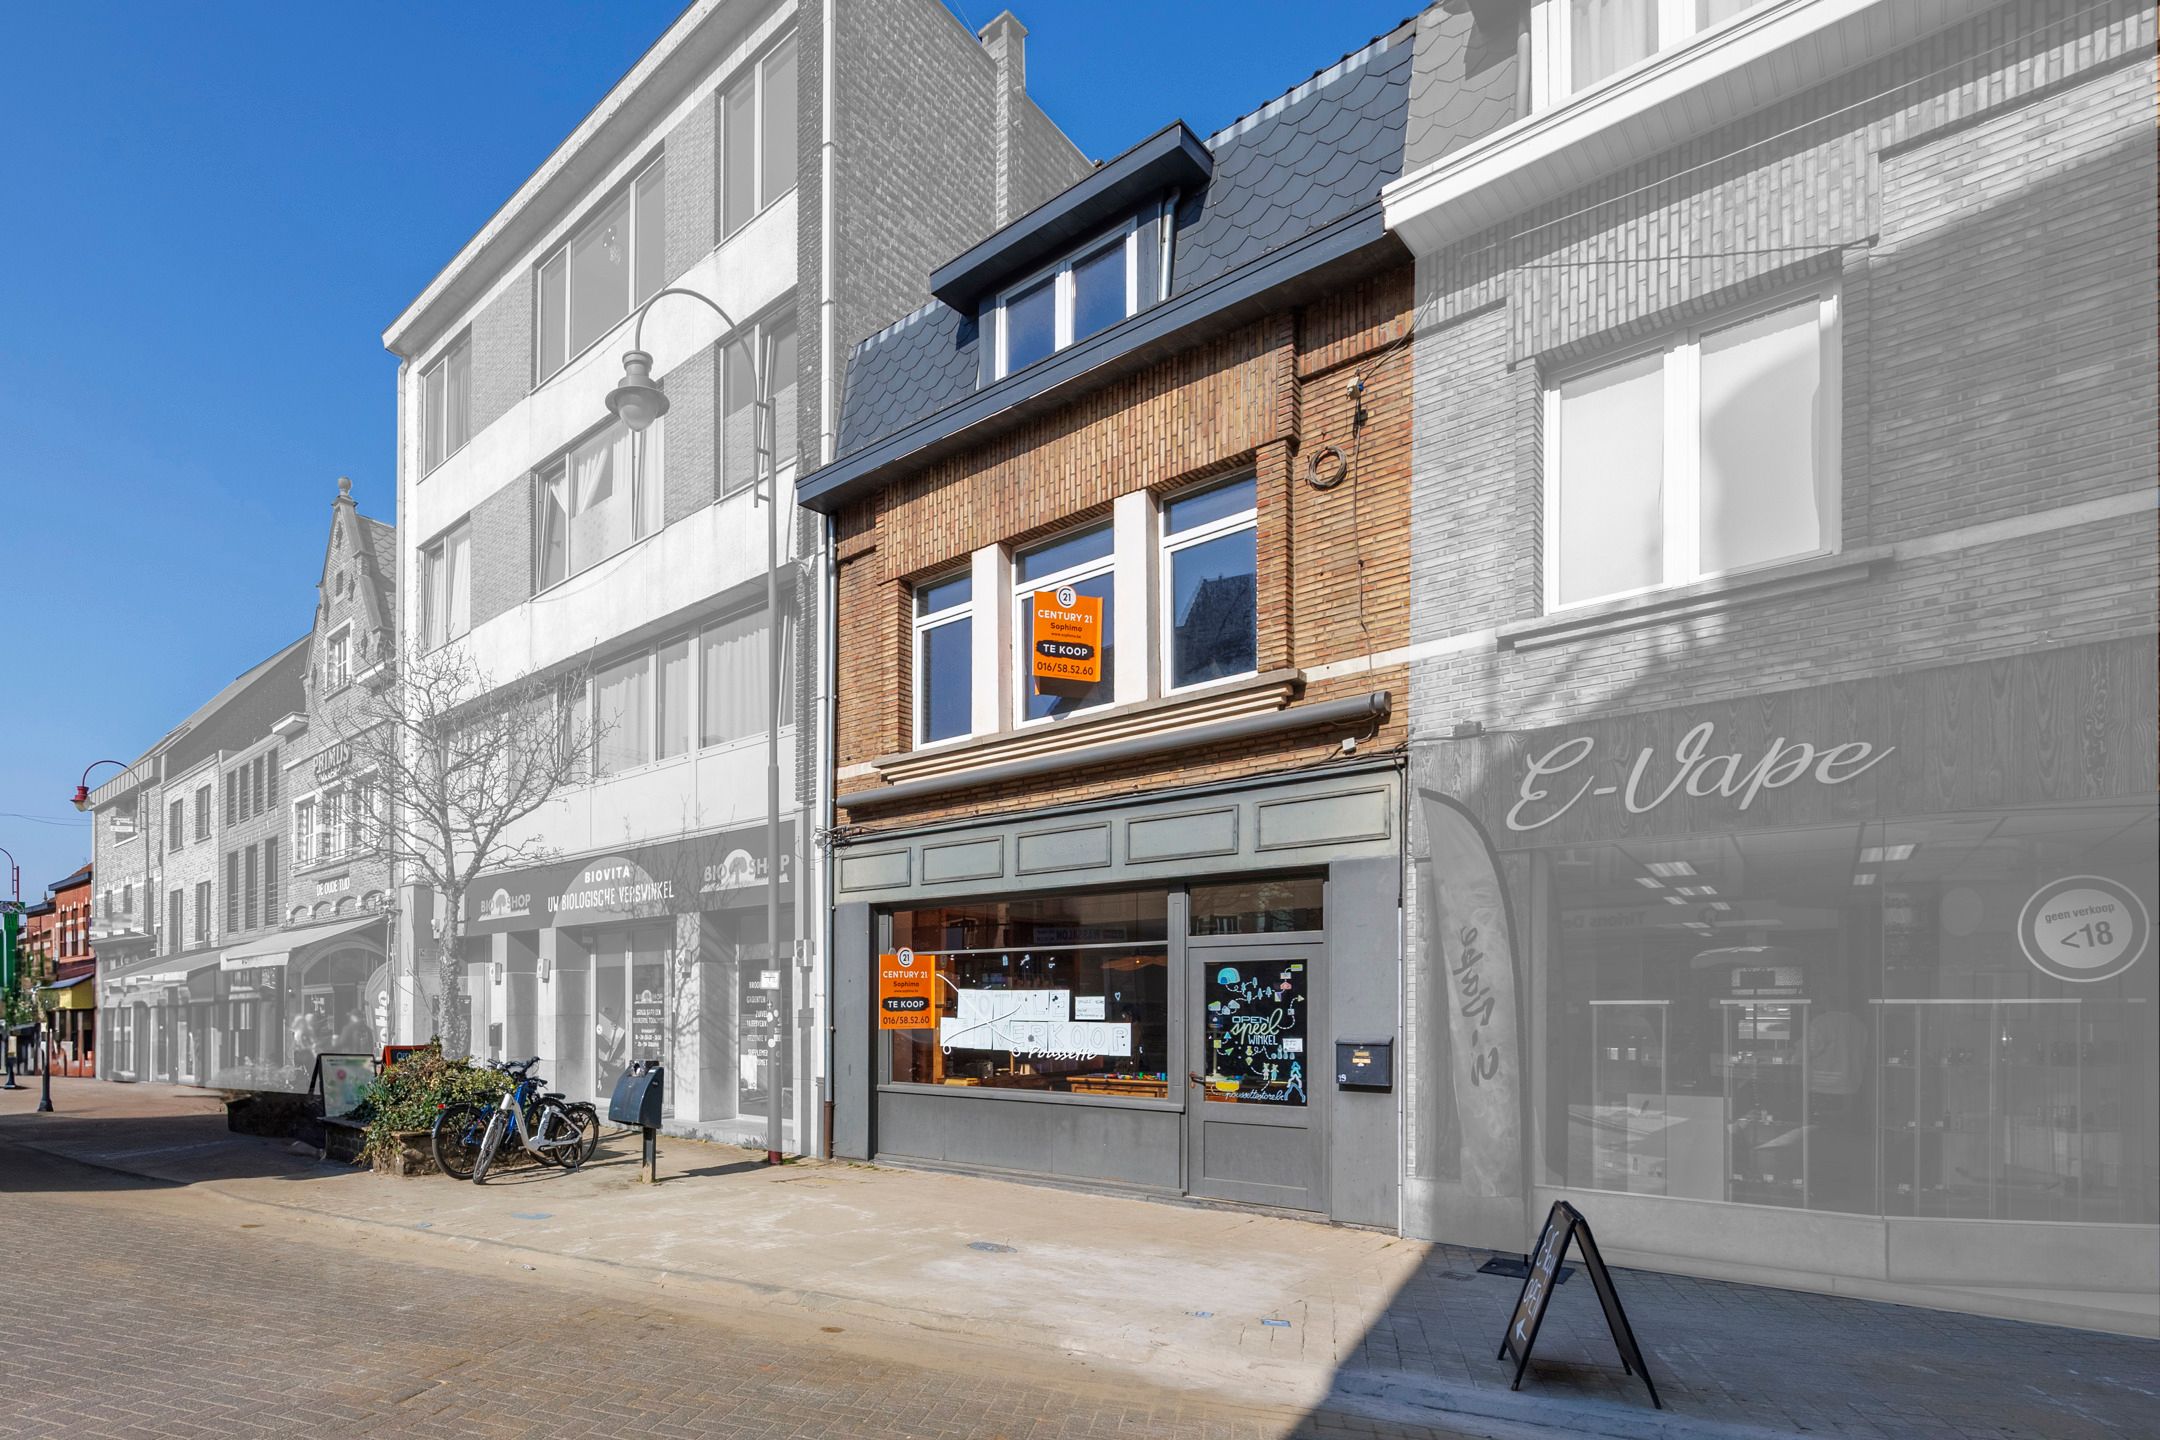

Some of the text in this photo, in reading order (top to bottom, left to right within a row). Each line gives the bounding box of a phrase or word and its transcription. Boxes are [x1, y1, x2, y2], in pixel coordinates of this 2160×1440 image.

[1063, 592, 1071, 601] 21
[1037, 609, 1093, 624] CENTURY 21
[1050, 622, 1082, 633] Sophimo
[1043, 643, 1088, 657] TE KOOP
[1037, 661, 1093, 676] 016/58.52.60
[313, 743, 350, 774] PRIMUS
[1506, 721, 1896, 831] E-Vape
[584, 865, 631, 884] BIOVITA
[704, 854, 790, 882] BIO SHP
[316, 884, 324, 896] DE
[324, 880, 338, 895] OUDE
[481, 893, 531, 913] BIO SHOP
[547, 880, 675, 913] UW BIOLOGISCHE VERSWINKEL
[2045, 903, 2115, 924] geen verkoop
[2060, 920, 2114, 949] <18
[882, 970, 928, 979] CENTURY 21
[888, 1000, 925, 1008] TE KOOP
[882, 1015, 930, 1025] 016/58.52.60
[1231, 1015, 1270, 1024] OPEN
[1231, 1007, 1283, 1045] speel
[1248, 1034, 1278, 1046] WINKEL
[1027, 1047, 1098, 1062] Poussette
